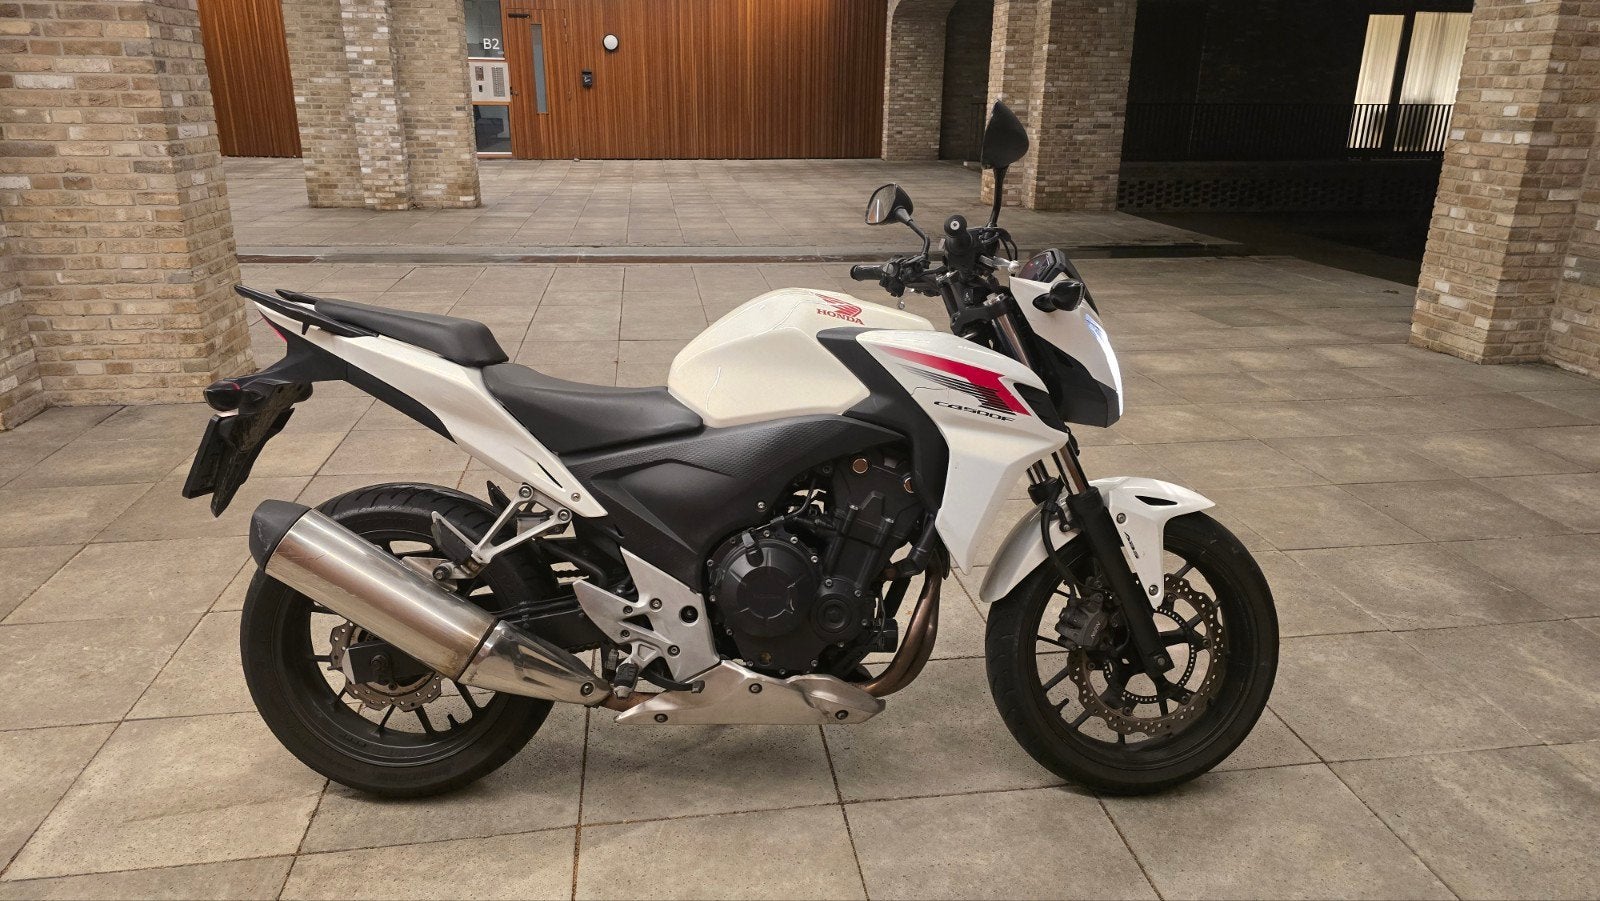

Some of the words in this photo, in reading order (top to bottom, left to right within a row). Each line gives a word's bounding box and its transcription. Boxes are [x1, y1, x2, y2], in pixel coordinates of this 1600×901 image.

[483, 38, 500, 50] B2
[816, 308, 865, 326] HONDA
[933, 401, 1016, 422] CB500F
